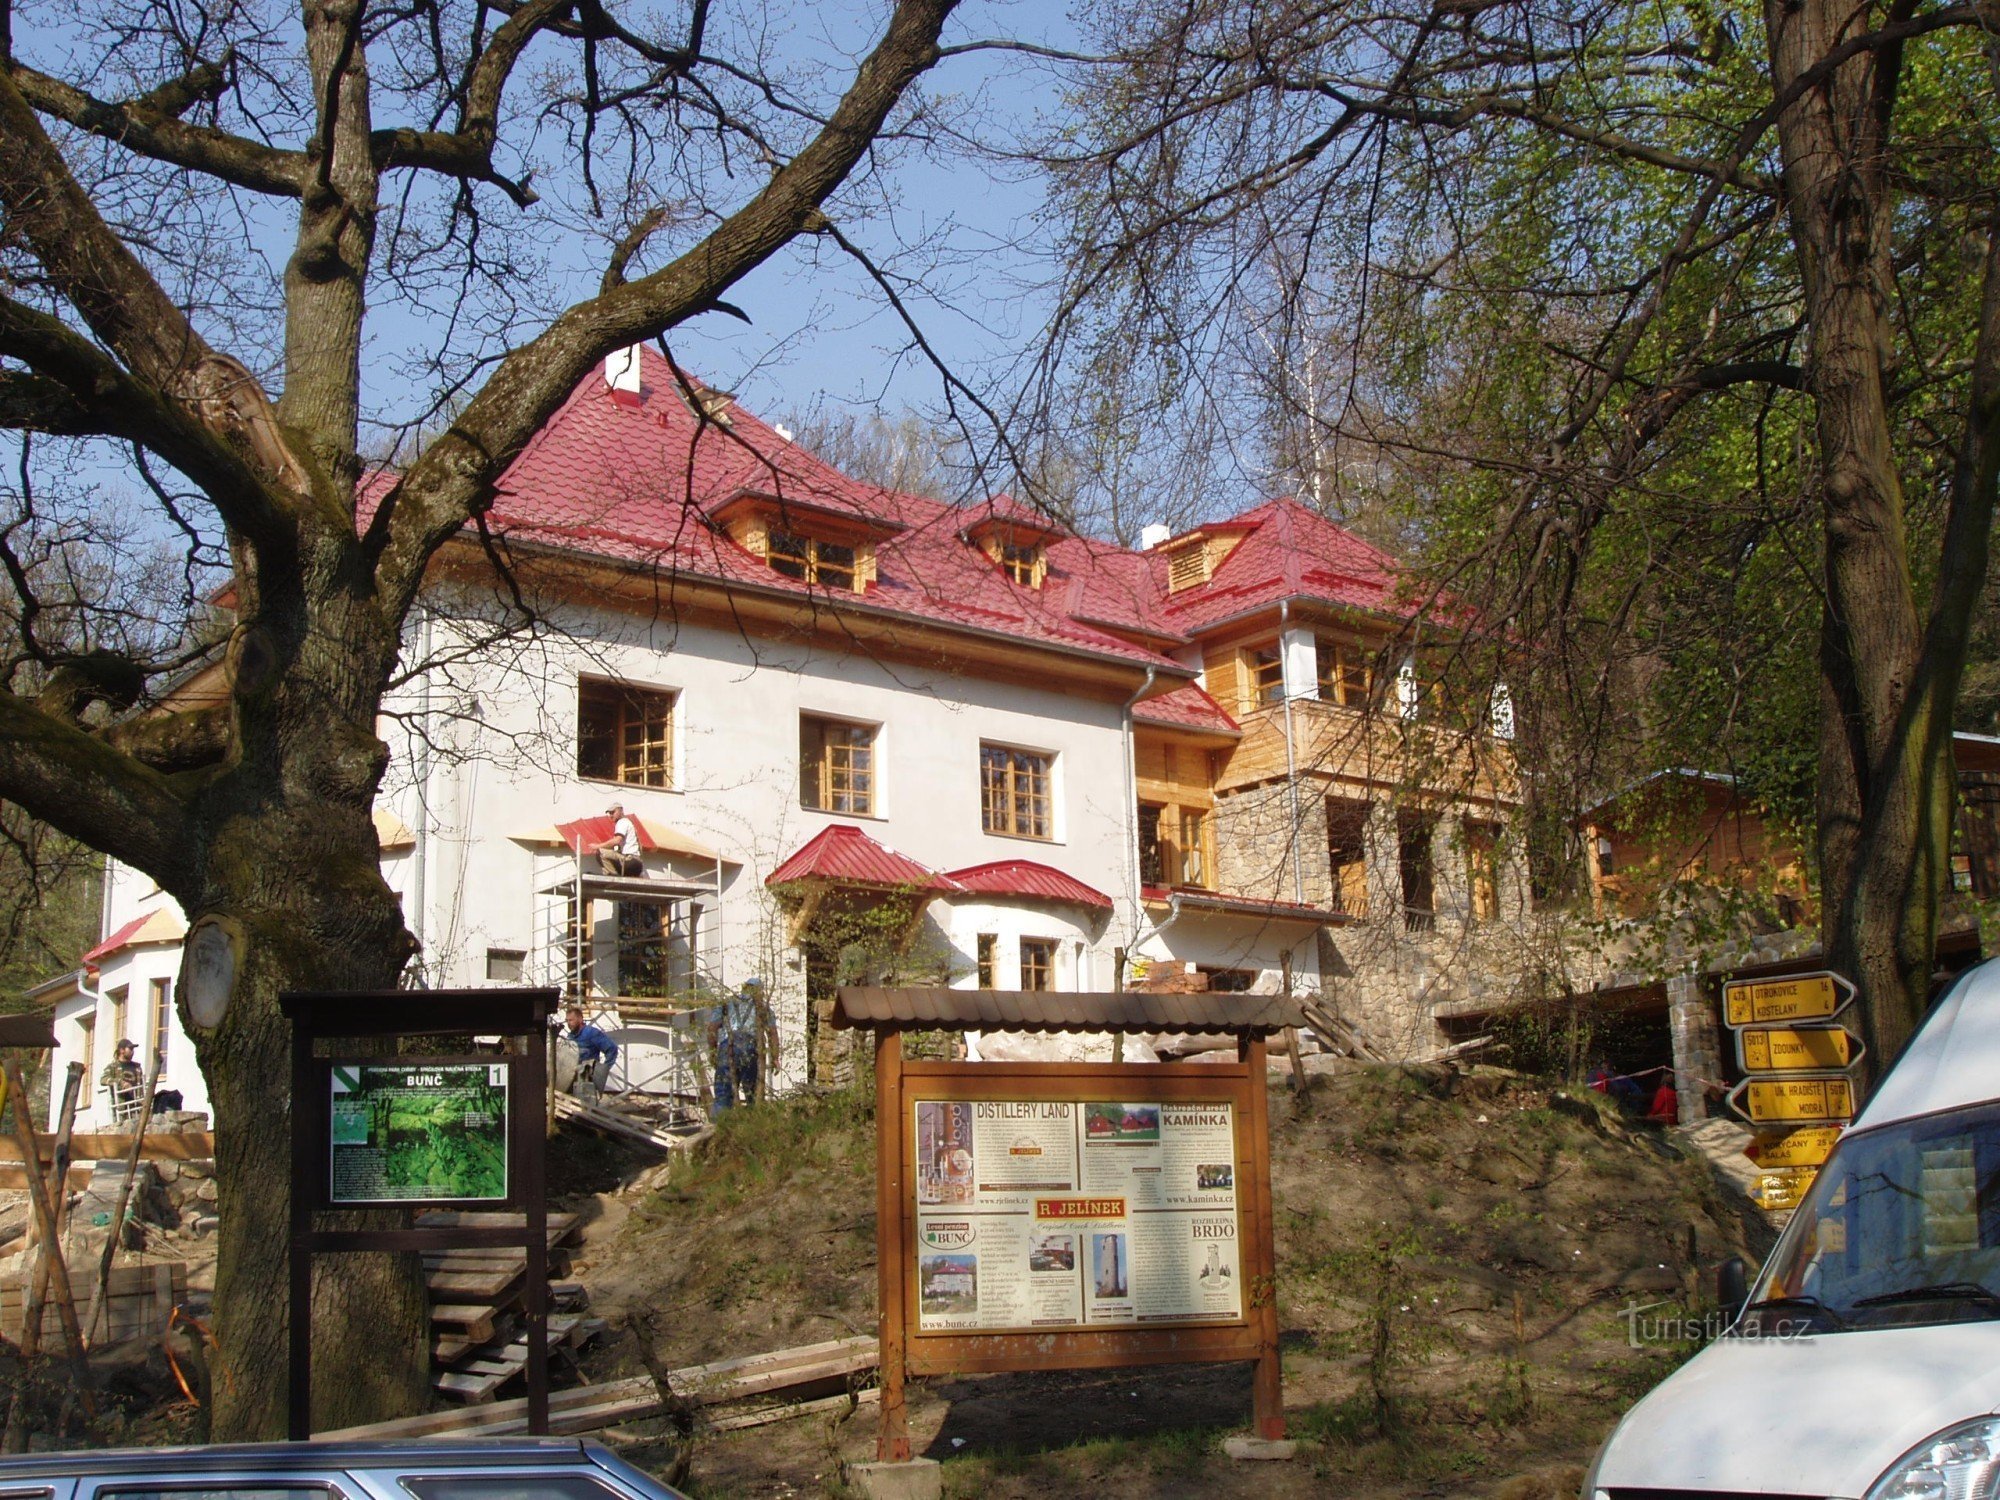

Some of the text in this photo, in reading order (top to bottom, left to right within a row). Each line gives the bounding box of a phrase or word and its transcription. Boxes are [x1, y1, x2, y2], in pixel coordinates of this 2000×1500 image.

[1734, 990, 1746, 1001] 473
[1755, 981, 1829, 1000] OTROKOVICE 16
[1757, 1003, 1797, 1017] KOSTELANY
[1748, 1034, 1764, 1046] 5013
[1773, 1042, 1845, 1055] ZDOUNKY 6
[406, 1074, 443, 1086] BUNČ
[492, 1068, 501, 1085] 1
[1751, 1086, 1760, 1098] 16
[977, 1104, 1070, 1118] DISTILLERY LAND
[1754, 1105, 1763, 1116] 10
[1163, 1113, 1228, 1126] KAMÍNKA
[1816, 1138, 1827, 1147] 25
[1823, 1148, 1828, 1156] 7
[1040, 1200, 1121, 1215] R. JELÍNEK
[1193, 1224, 1235, 1237] BRDO
[938, 1231, 970, 1243] BUNČ
